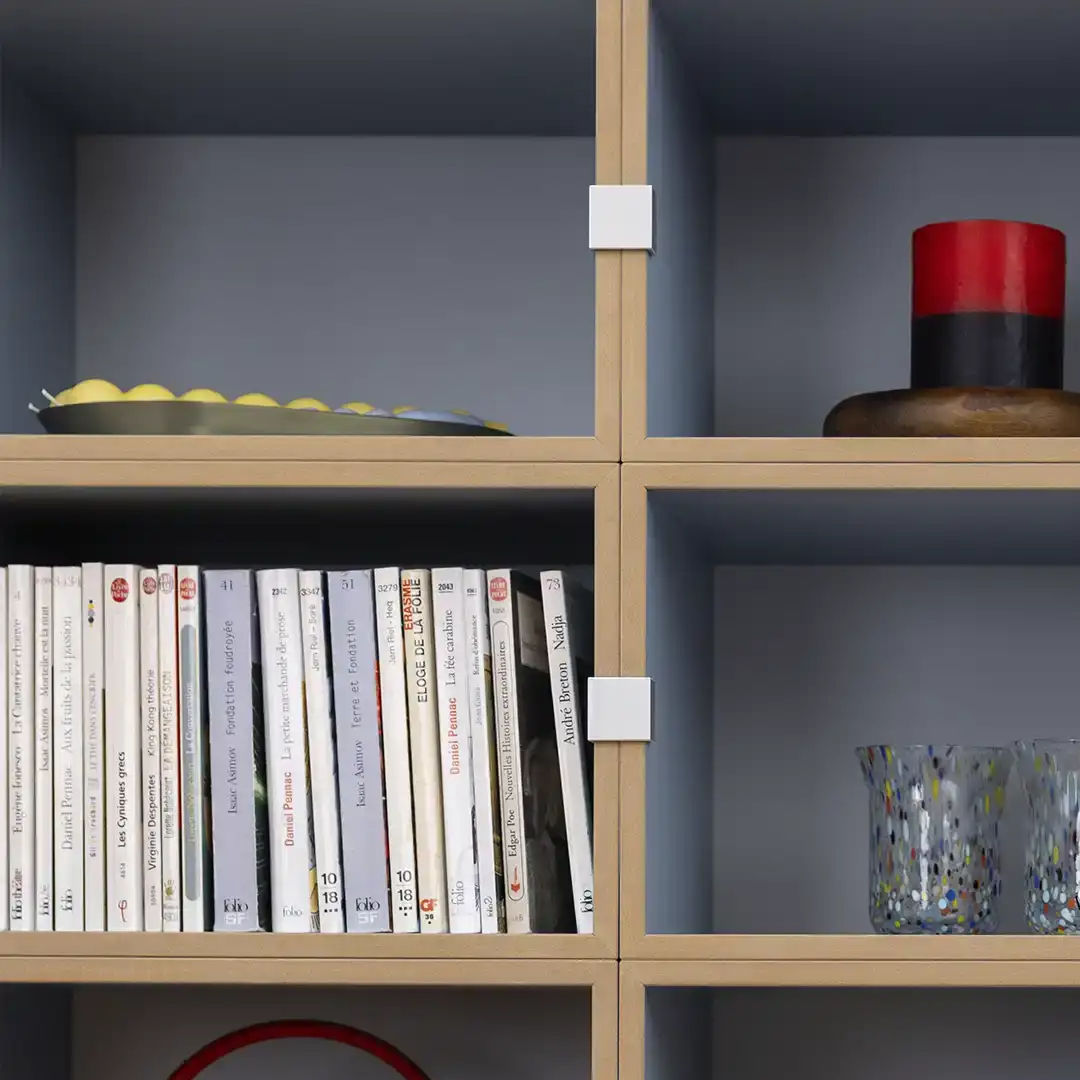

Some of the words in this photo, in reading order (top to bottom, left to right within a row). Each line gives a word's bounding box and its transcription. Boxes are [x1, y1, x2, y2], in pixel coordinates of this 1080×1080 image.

[220, 580, 233, 591] 41
[341, 579, 354, 590] 51
[378, 584, 398, 593] 3279
[411, 578, 422, 615] FOLIE
[438, 583, 454, 591] 2043
[547, 579, 560, 590] 73
[402, 579, 413, 630] ERASME
[40, 628, 50, 638] la
[62, 615, 76, 660] passion
[276, 612, 290, 639] prose
[412, 618, 424, 635] LA
[441, 610, 455, 653] carabine
[551, 614, 568, 651] Nadja
[223, 620, 237, 675] foudroyée
[277, 641, 288, 653] de
[345, 619, 359, 674] Fondation
[414, 638, 425, 656] DE
[61, 662, 73, 673] la
[443, 655, 455, 670] fée
[497, 640, 511, 709] extraordinaires
[61, 675, 73, 691] de
[145, 669, 156, 704] théorie
[277, 656, 290, 712] marchande
[348, 681, 360, 693] et
[415, 662, 428, 703] ELOGE
[444, 673, 456, 686] La
[556, 662, 570, 703] Breton
[61, 694, 73, 726] fruits
[146, 708, 157, 734] Kong
[161, 671, 173, 754] DÉMANGEAISON
[225, 681, 236, 735] Fondation
[350, 698, 361, 729] Terre
[446, 698, 459, 737] Pennac
[12, 720, 23, 734] La
[280, 715, 294, 745] petite
[501, 710, 512, 753] Histoires
[561, 707, 576, 746] André
[62, 728, 73, 754] Aux
[146, 737, 157, 757] King
[280, 747, 291, 760] La
[117, 751, 128, 779] grecs
[226, 747, 237, 787] Asimov
[355, 740, 365, 780] Asimov
[448, 740, 460, 775] Daniel
[62, 765, 73, 808] Pennac
[282, 771, 294, 811] Pennac
[504, 755, 514, 801] Nouvelles
[117, 782, 129, 829] Cyniques
[147, 774, 158, 828] Despentes
[227, 789, 238, 814] Isaac
[357, 782, 367, 808] Isaac
[61, 812, 73, 850] Daniel
[283, 813, 295, 847] Daniel
[506, 810, 516, 828] Poe
[116, 830, 126, 848] Les
[147, 830, 158, 870] Virginie
[506, 829, 519, 857] Edgar
[321, 872, 338, 885] 10
[397, 870, 411, 884] 10
[224, 898, 249, 913] folio
[322, 891, 338, 903] 18
[355, 896, 380, 911] folio
[398, 889, 413, 902] 18
[451, 880, 465, 906] folio
